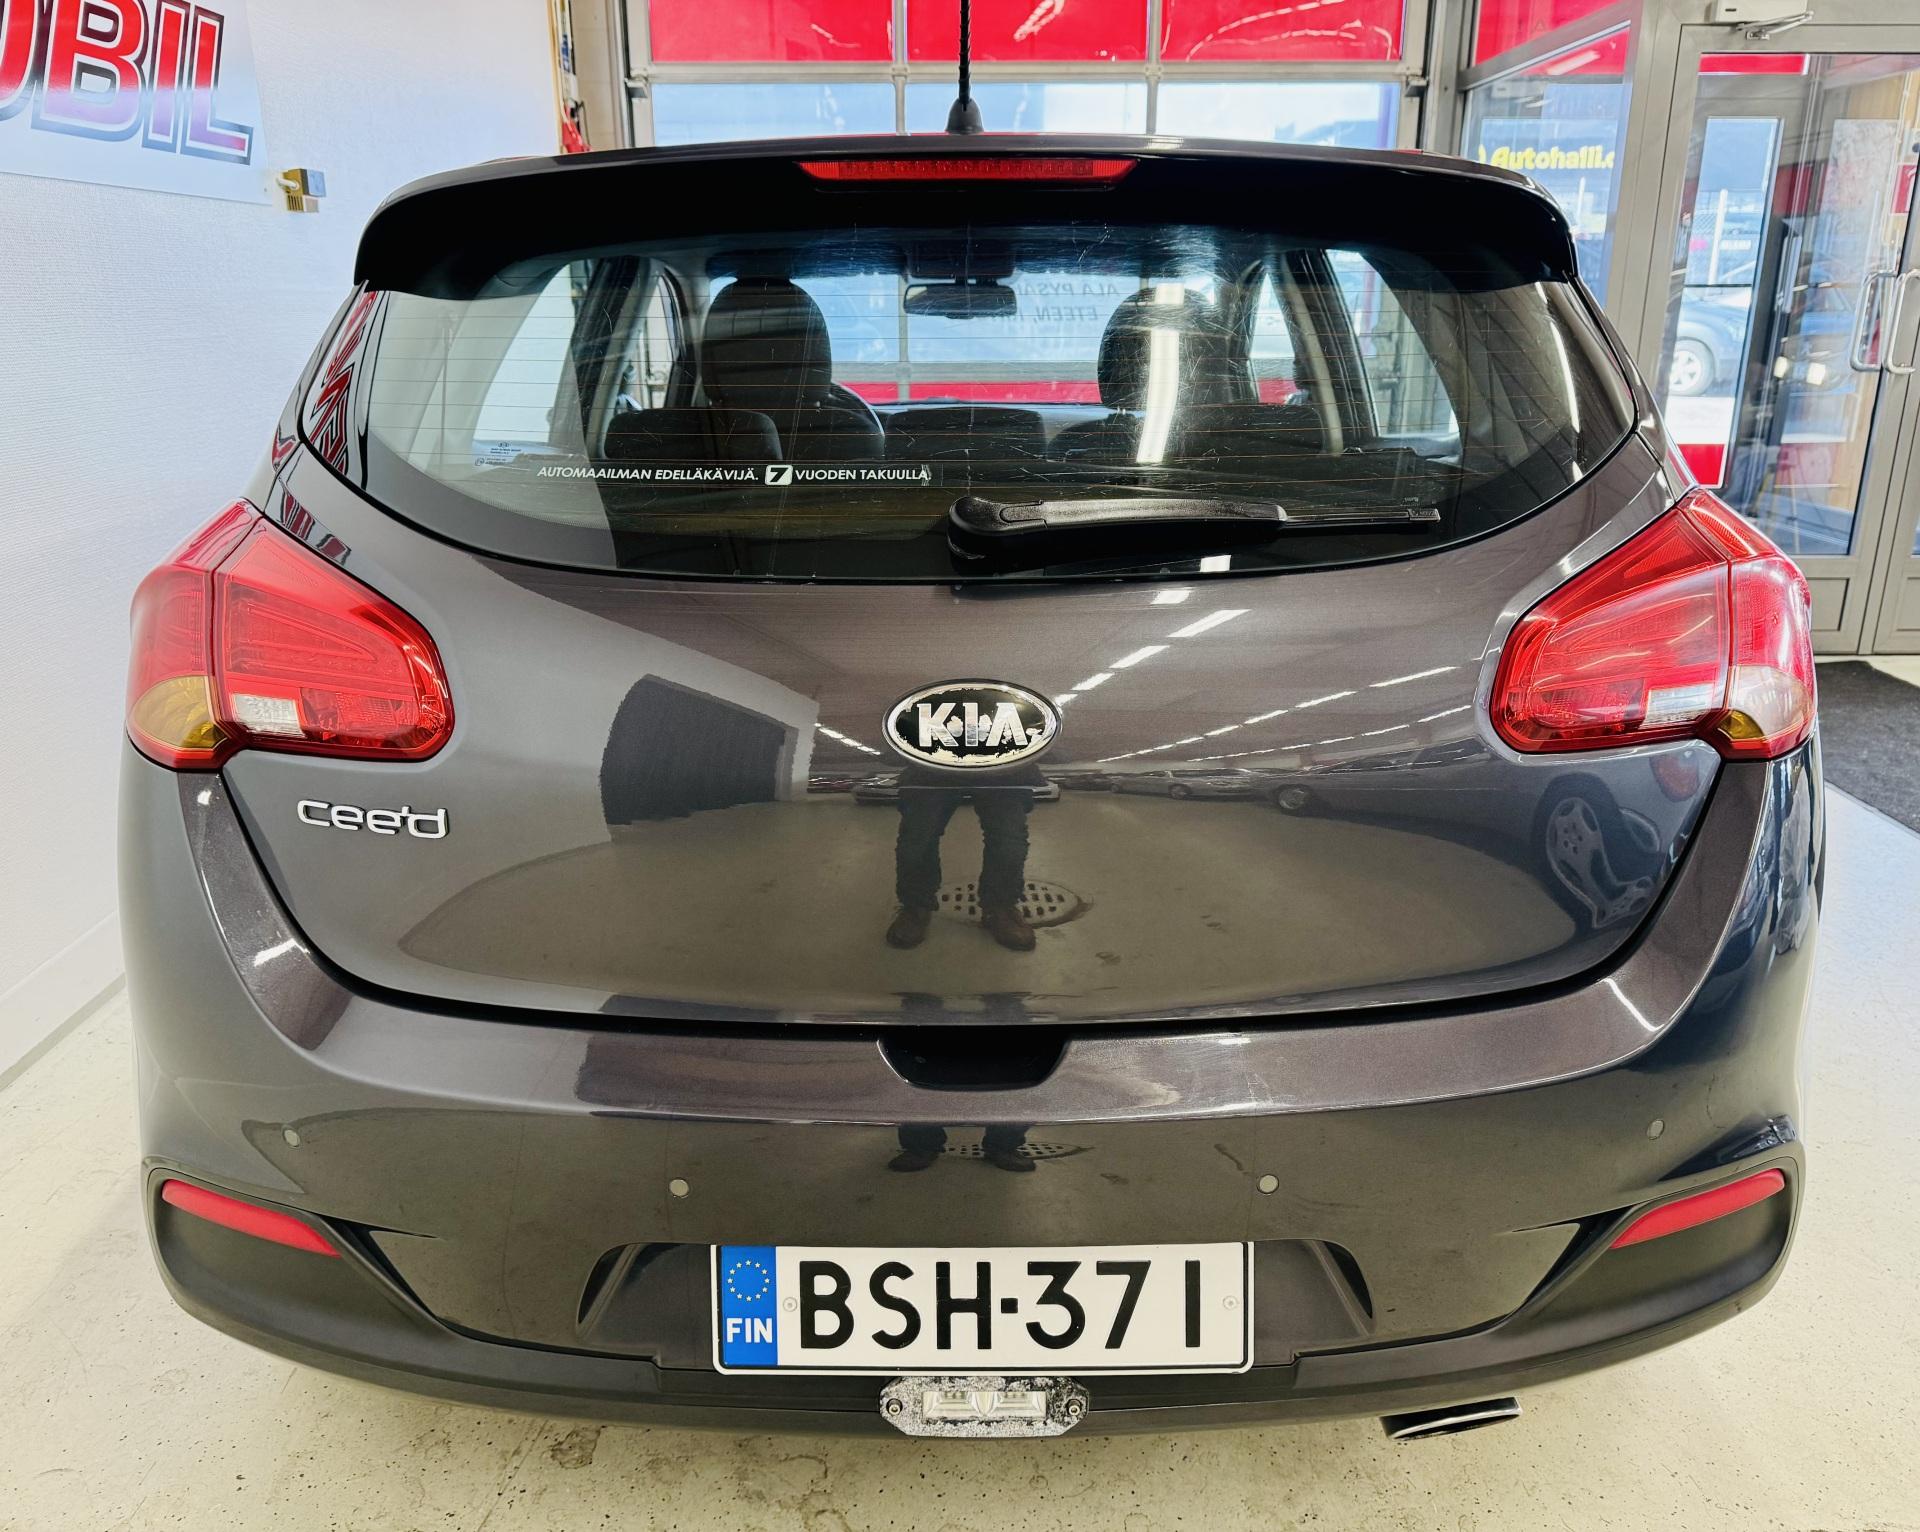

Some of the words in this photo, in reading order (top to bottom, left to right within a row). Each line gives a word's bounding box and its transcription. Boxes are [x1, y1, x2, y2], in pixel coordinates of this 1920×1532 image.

[536, 466, 651, 480] AUTOMAAILMAN
[655, 467, 759, 481] EDELLÄKÄVIJÄ.
[768, 466, 791, 484] 7
[795, 469, 856, 481] VUODEN
[917, 702, 1028, 747] KIA
[799, 1260, 1201, 1350] BSH-371
[726, 1317, 773, 1343] FIN
